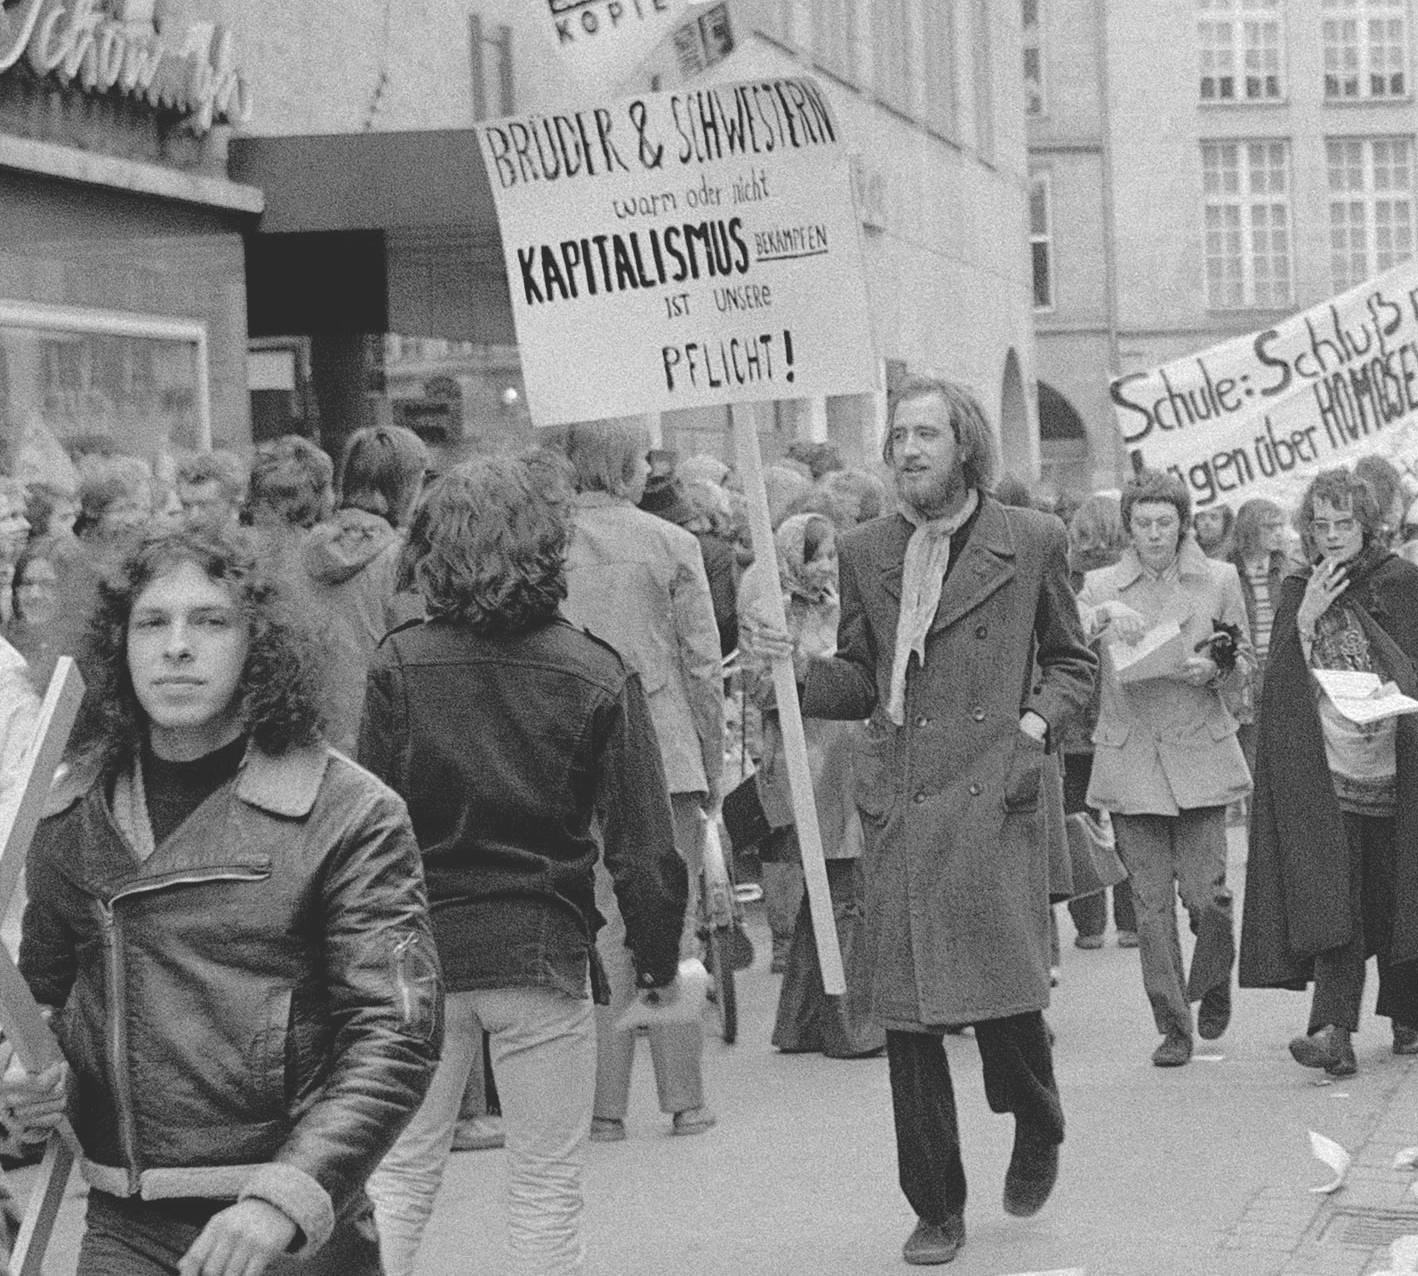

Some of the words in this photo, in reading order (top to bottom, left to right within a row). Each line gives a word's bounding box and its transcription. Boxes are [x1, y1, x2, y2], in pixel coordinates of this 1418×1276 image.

[486, 108, 630, 188] BRÜDER
[629, 100, 664, 169] &
[671, 80, 836, 164] SCHWESTERN
[612, 191, 678, 219] warm
[686, 174, 722, 208] oder
[733, 168, 769, 204] nicht
[517, 217, 750, 305] KAPITALISMUS
[664, 293, 690, 318] IST
[662, 329, 796, 392] PFLICHT!
[1109, 357, 1255, 444] Schule:
[1253, 291, 1402, 397] Schluß
[1254, 414, 1319, 478] über
